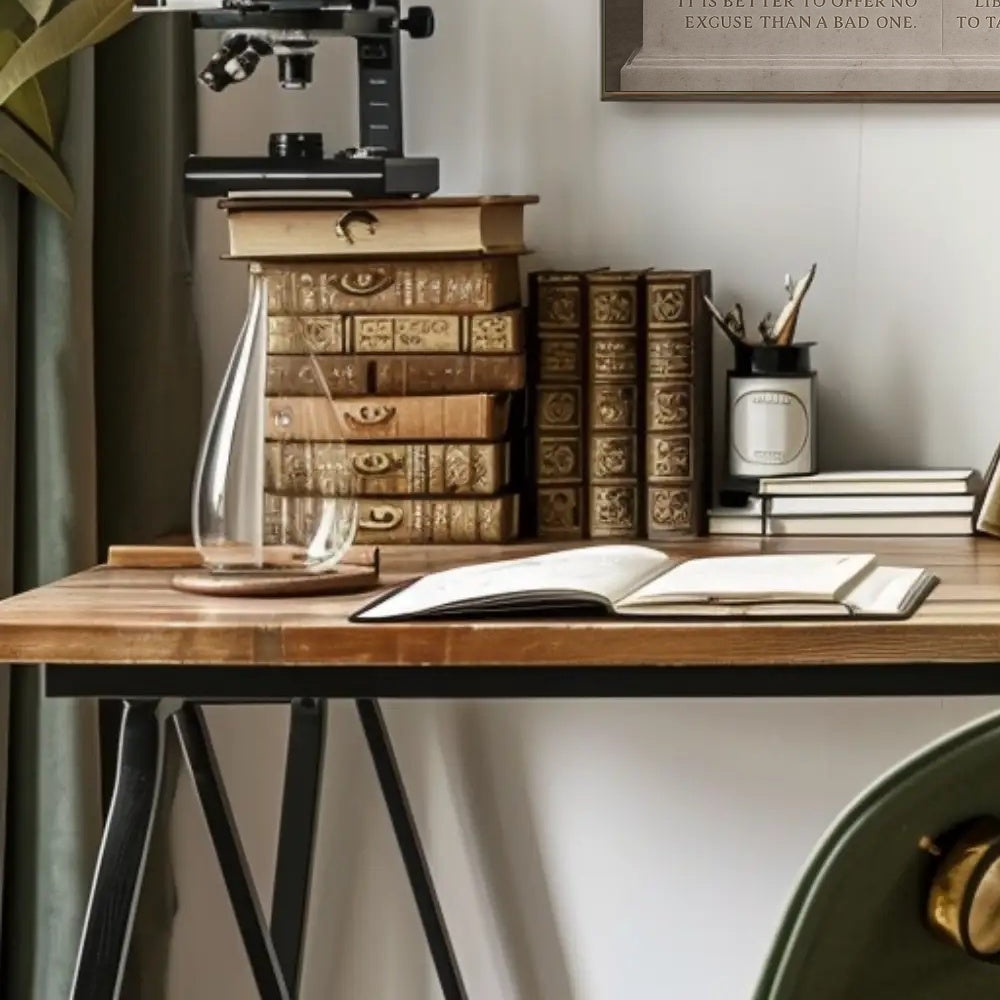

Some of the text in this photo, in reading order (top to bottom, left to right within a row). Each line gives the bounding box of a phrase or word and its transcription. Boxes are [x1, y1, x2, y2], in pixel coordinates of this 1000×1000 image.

[759, 15, 812, 29] THAN
[815, 15, 829, 29] A
[833, 15, 870, 29] BAD
[875, 15, 917, 29] ONE.
[956, 15, 981, 29] TO
